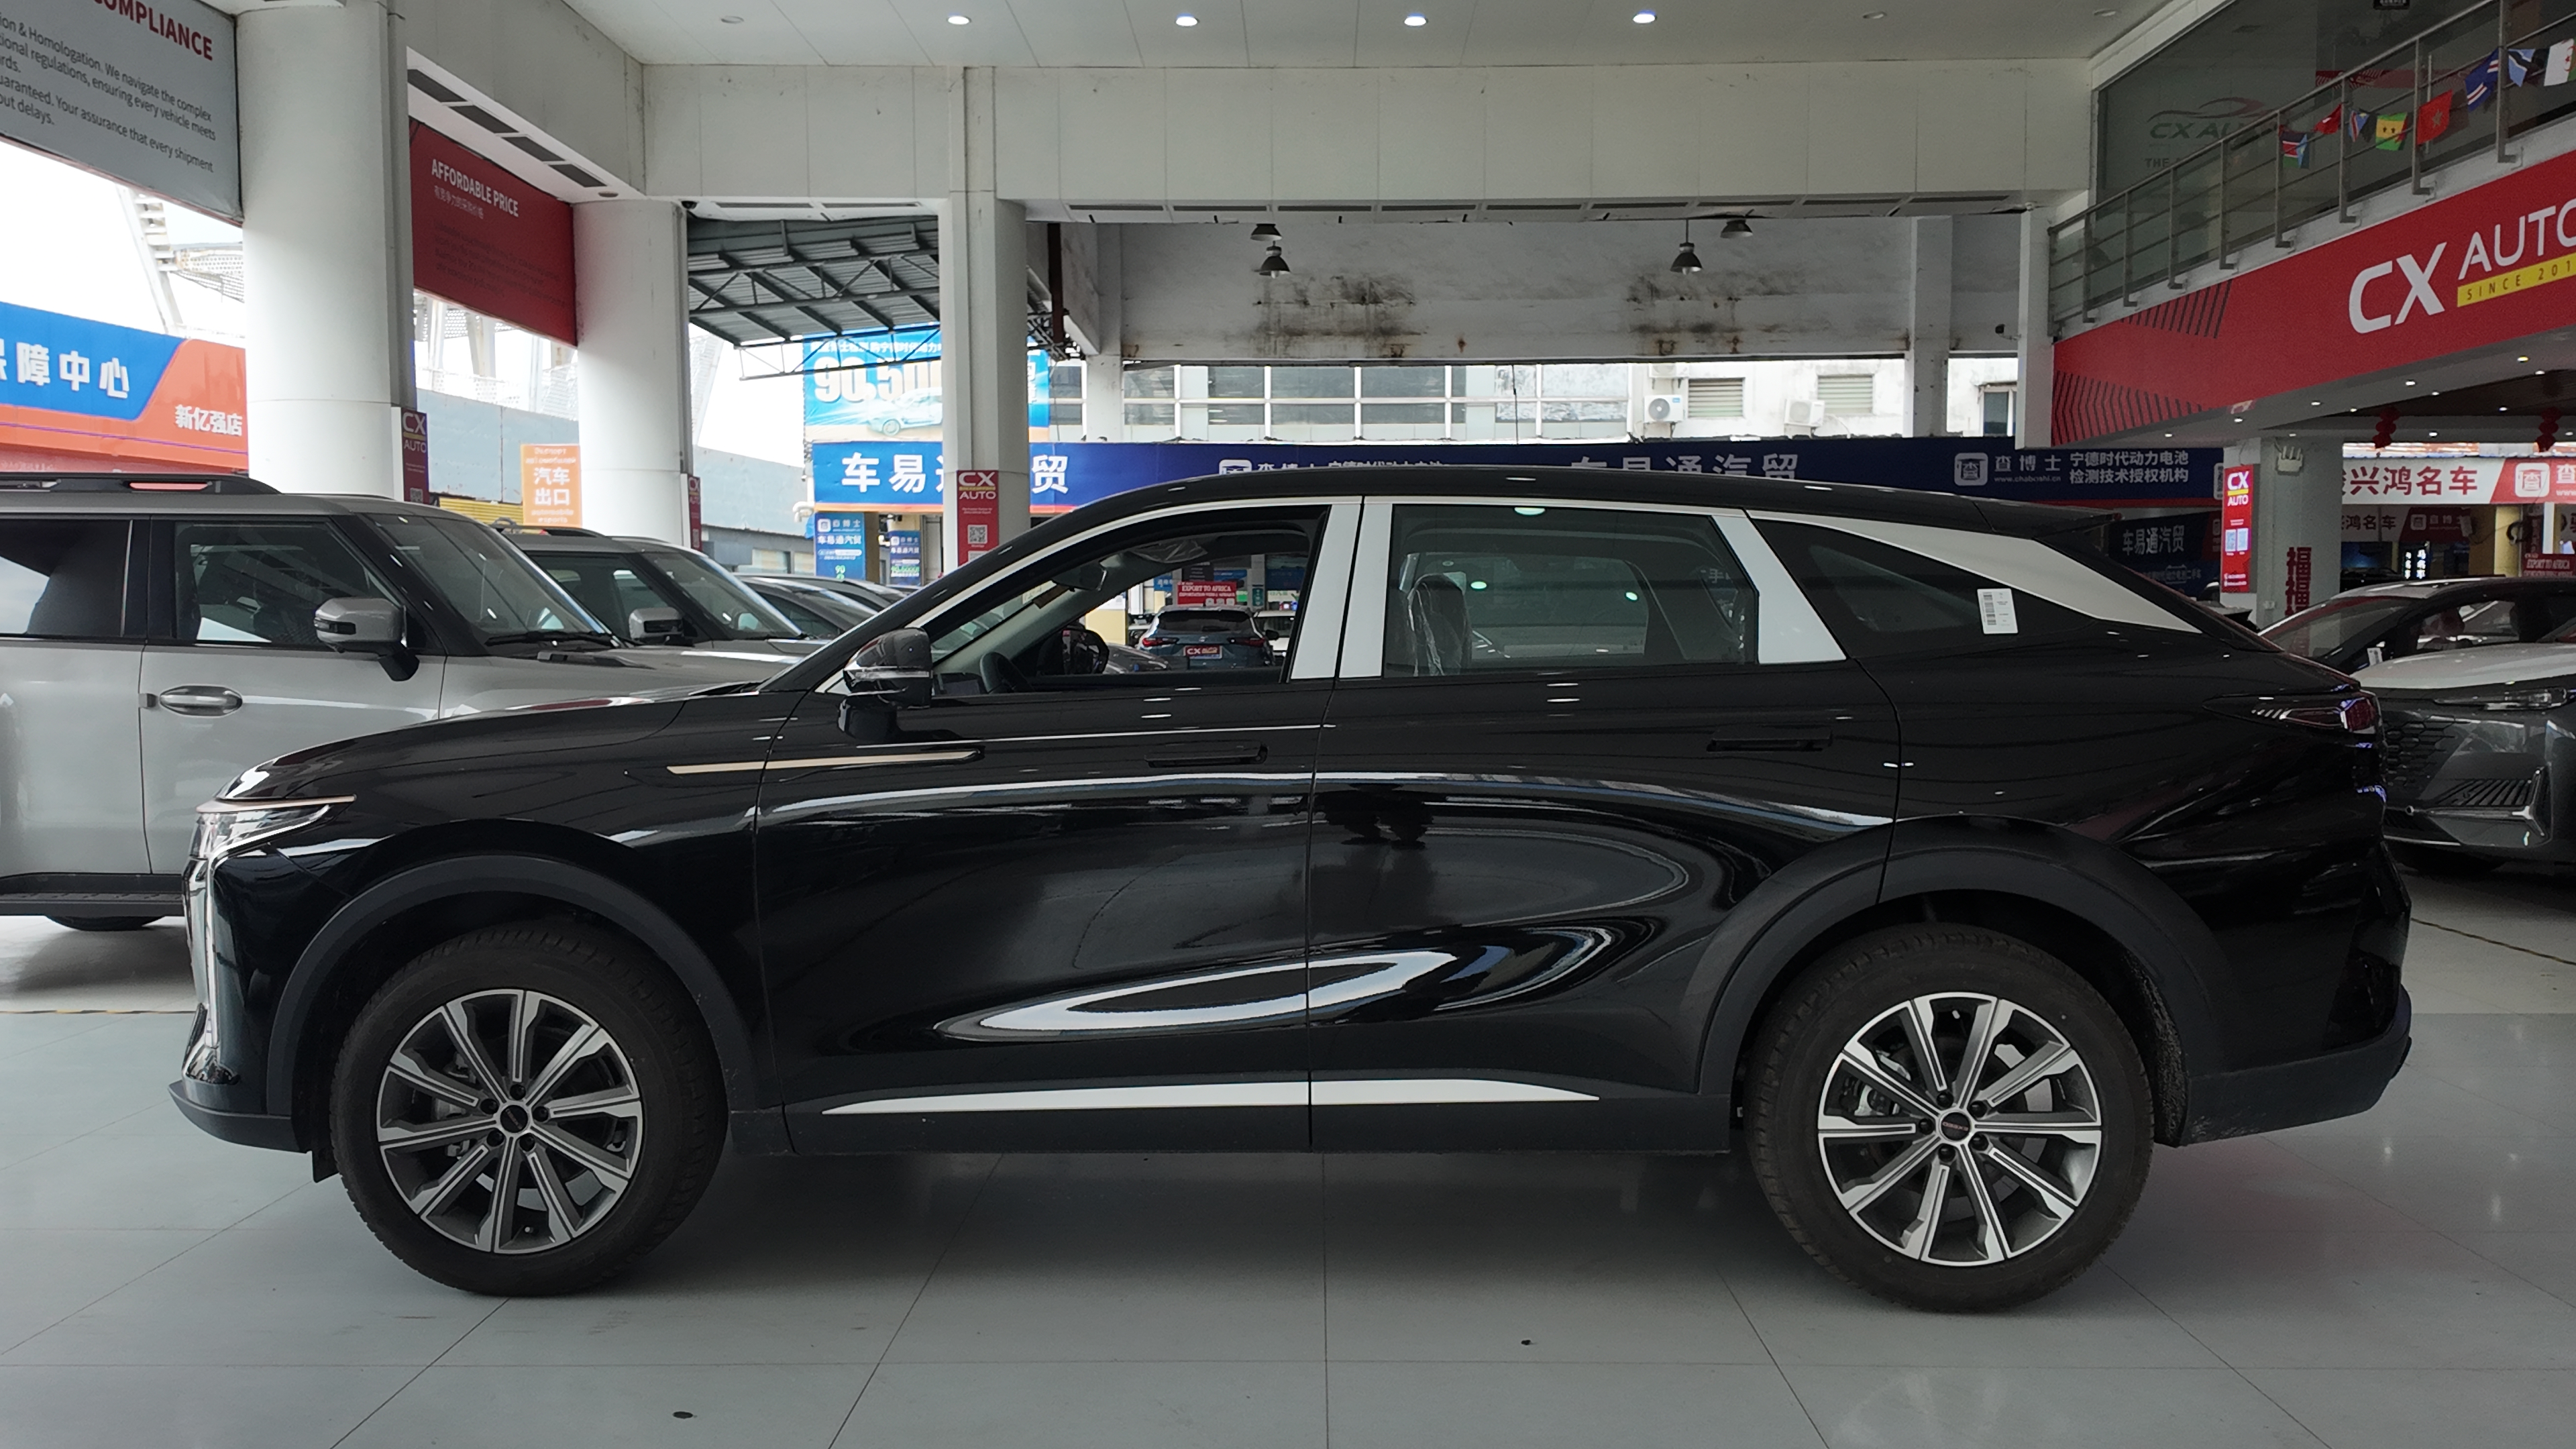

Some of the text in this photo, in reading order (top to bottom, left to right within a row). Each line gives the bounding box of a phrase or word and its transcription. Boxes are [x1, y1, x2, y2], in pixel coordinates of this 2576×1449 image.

[94, 0, 213, 60] MPLIANCE
[19, 22, 28, 38] &
[29, 27, 103, 72] Homologation.
[105, 62, 120, 80] We
[122, 73, 160, 99] navigate
[161, 89, 176, 106] the
[176, 97, 212, 122] complex
[31, 49, 91, 87] regulations,
[92, 76, 133, 107] ensuring
[134, 96, 159, 118] every
[160, 105, 191, 129] vehicle
[191, 119, 216, 141] meets
[17, 99, 55, 125] delays.
[56, 95, 79, 116] Your
[80, 107, 128, 138] assurance
[129, 127, 148, 147] that
[149, 137, 173, 159] every
[174, 146, 214, 173] shipment
[431, 158, 519, 217] AFFORDABLE PRICE
[2349, 197, 2576, 333] CX AUTO
[2467, 274, 2521, 301] SINCE
[0, 338, 129, 399] 障中心
[175, 404, 243, 437] 新亿强店
[403, 411, 426, 435] CX
[404, 439, 427, 453] AUTO
[1994, 455, 2061, 472] 查博士
[2070, 451, 2189, 467] 宁德时代动力电池
[534, 466, 570, 485] 汽车
[959, 472, 996, 486] CX
[2070, 468, 2189, 485] 检测技术授权机构
[2227, 471, 2249, 490] CX
[2342, 466, 2477, 496] 兴鸿名车
[535, 488, 570, 506] 出口
[959, 491, 997, 500] AUTO
[2227, 495, 2249, 506] AUTO
[2341, 515, 2396, 531] 鸿名车
[2122, 525, 2185, 556] 车易通汽贸
